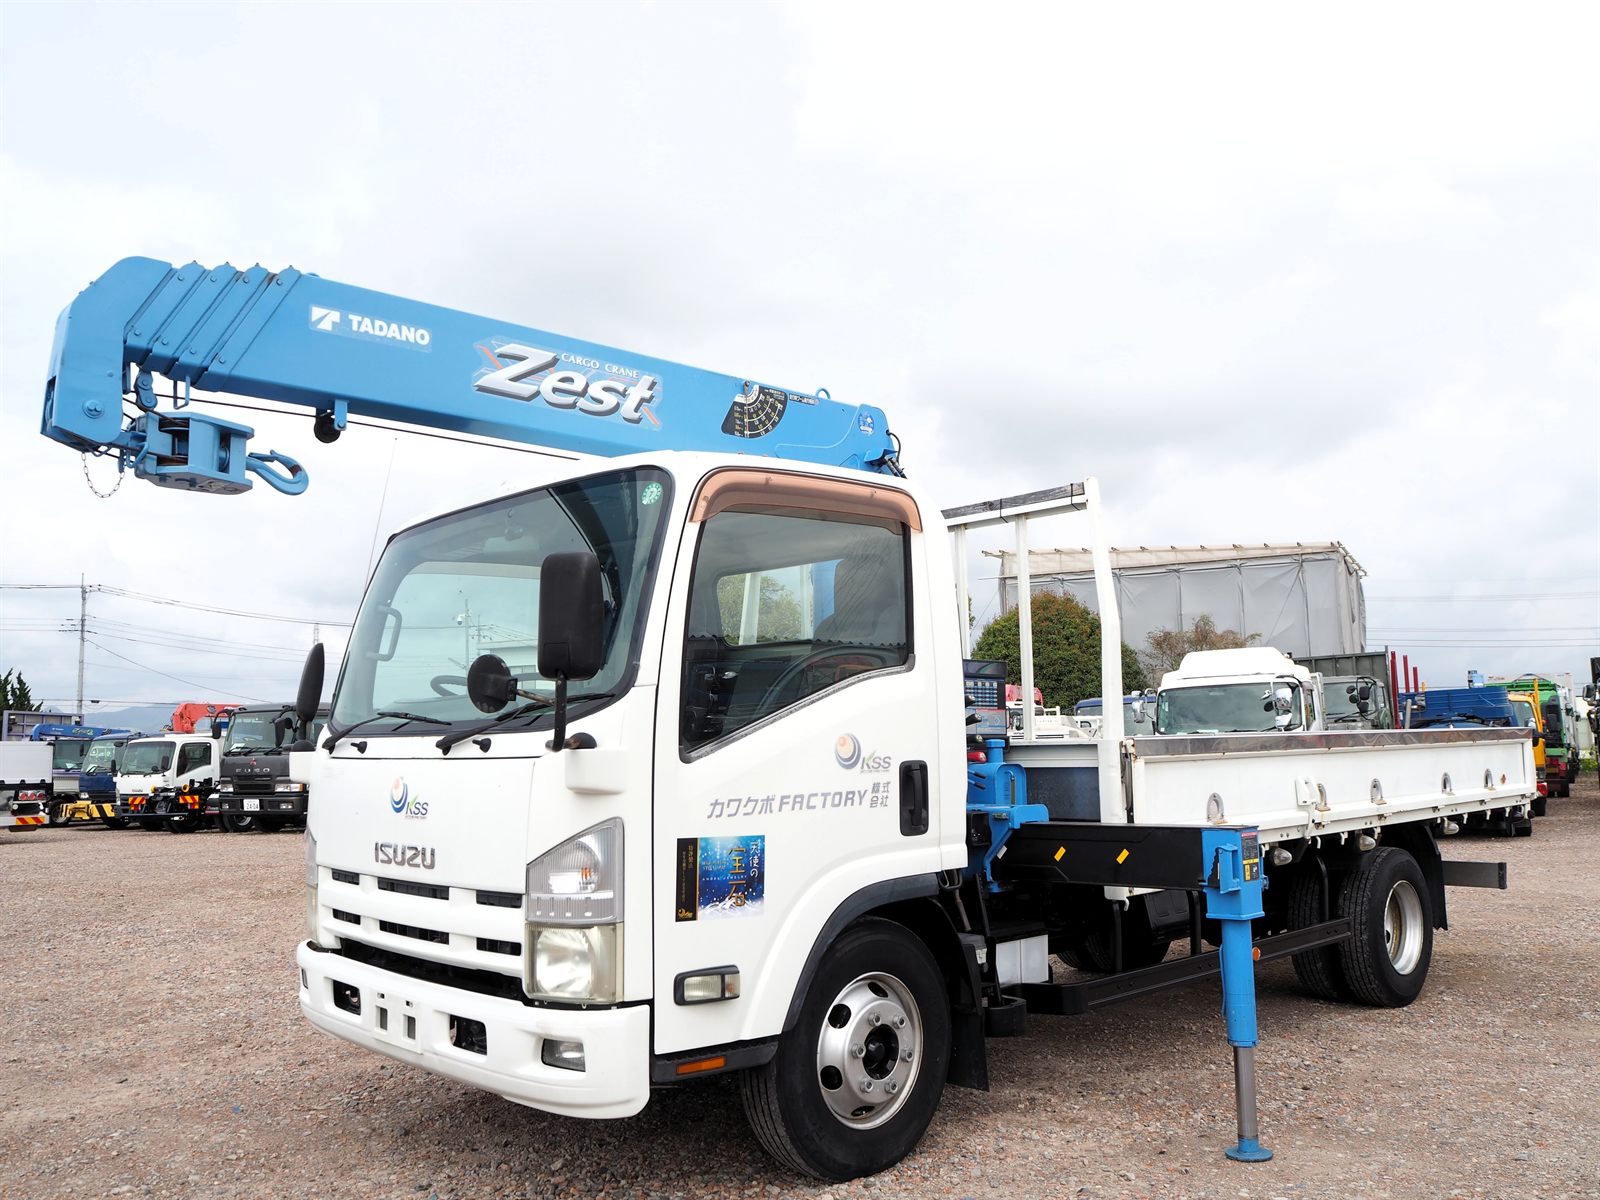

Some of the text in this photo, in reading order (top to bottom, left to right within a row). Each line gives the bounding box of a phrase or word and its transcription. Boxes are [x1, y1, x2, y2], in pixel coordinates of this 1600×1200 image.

[348, 313, 431, 347] TADANO
[561, 352, 640, 379] CARGO CRANE
[473, 342, 657, 424] Zest
[860, 751, 891, 769] KSS
[405, 795, 429, 815] KSS
[375, 842, 435, 869] ISUZU
[749, 841, 760, 878] 天使の
[728, 846, 747, 907] 宝石
